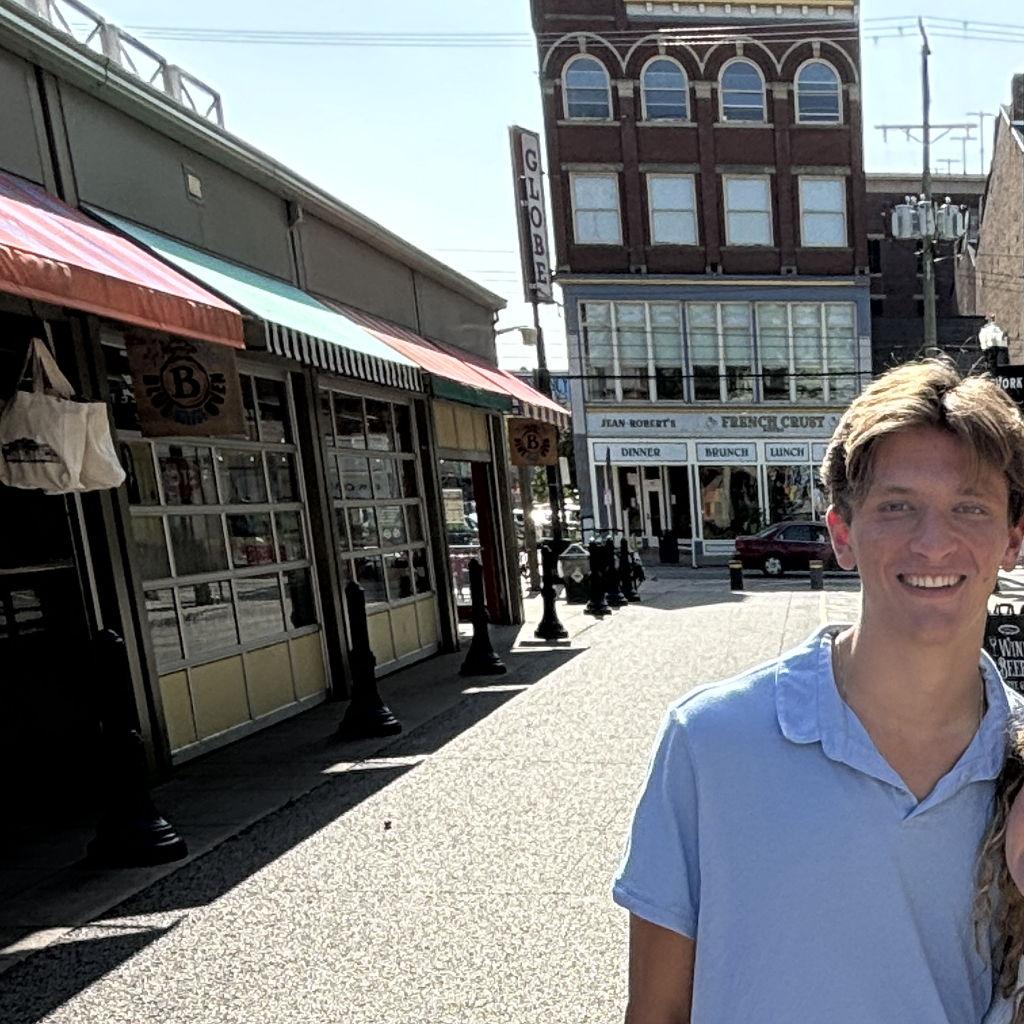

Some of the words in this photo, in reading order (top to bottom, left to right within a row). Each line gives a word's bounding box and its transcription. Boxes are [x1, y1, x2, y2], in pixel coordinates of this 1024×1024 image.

[525, 149, 547, 284] GLOBE
[721, 415, 778, 428] FRENCH
[780, 415, 826, 428] CRUST
[621, 447, 661, 457] DINNER
[705, 447, 749, 457] BRUNCH
[770, 447, 805, 457] LUNCH
